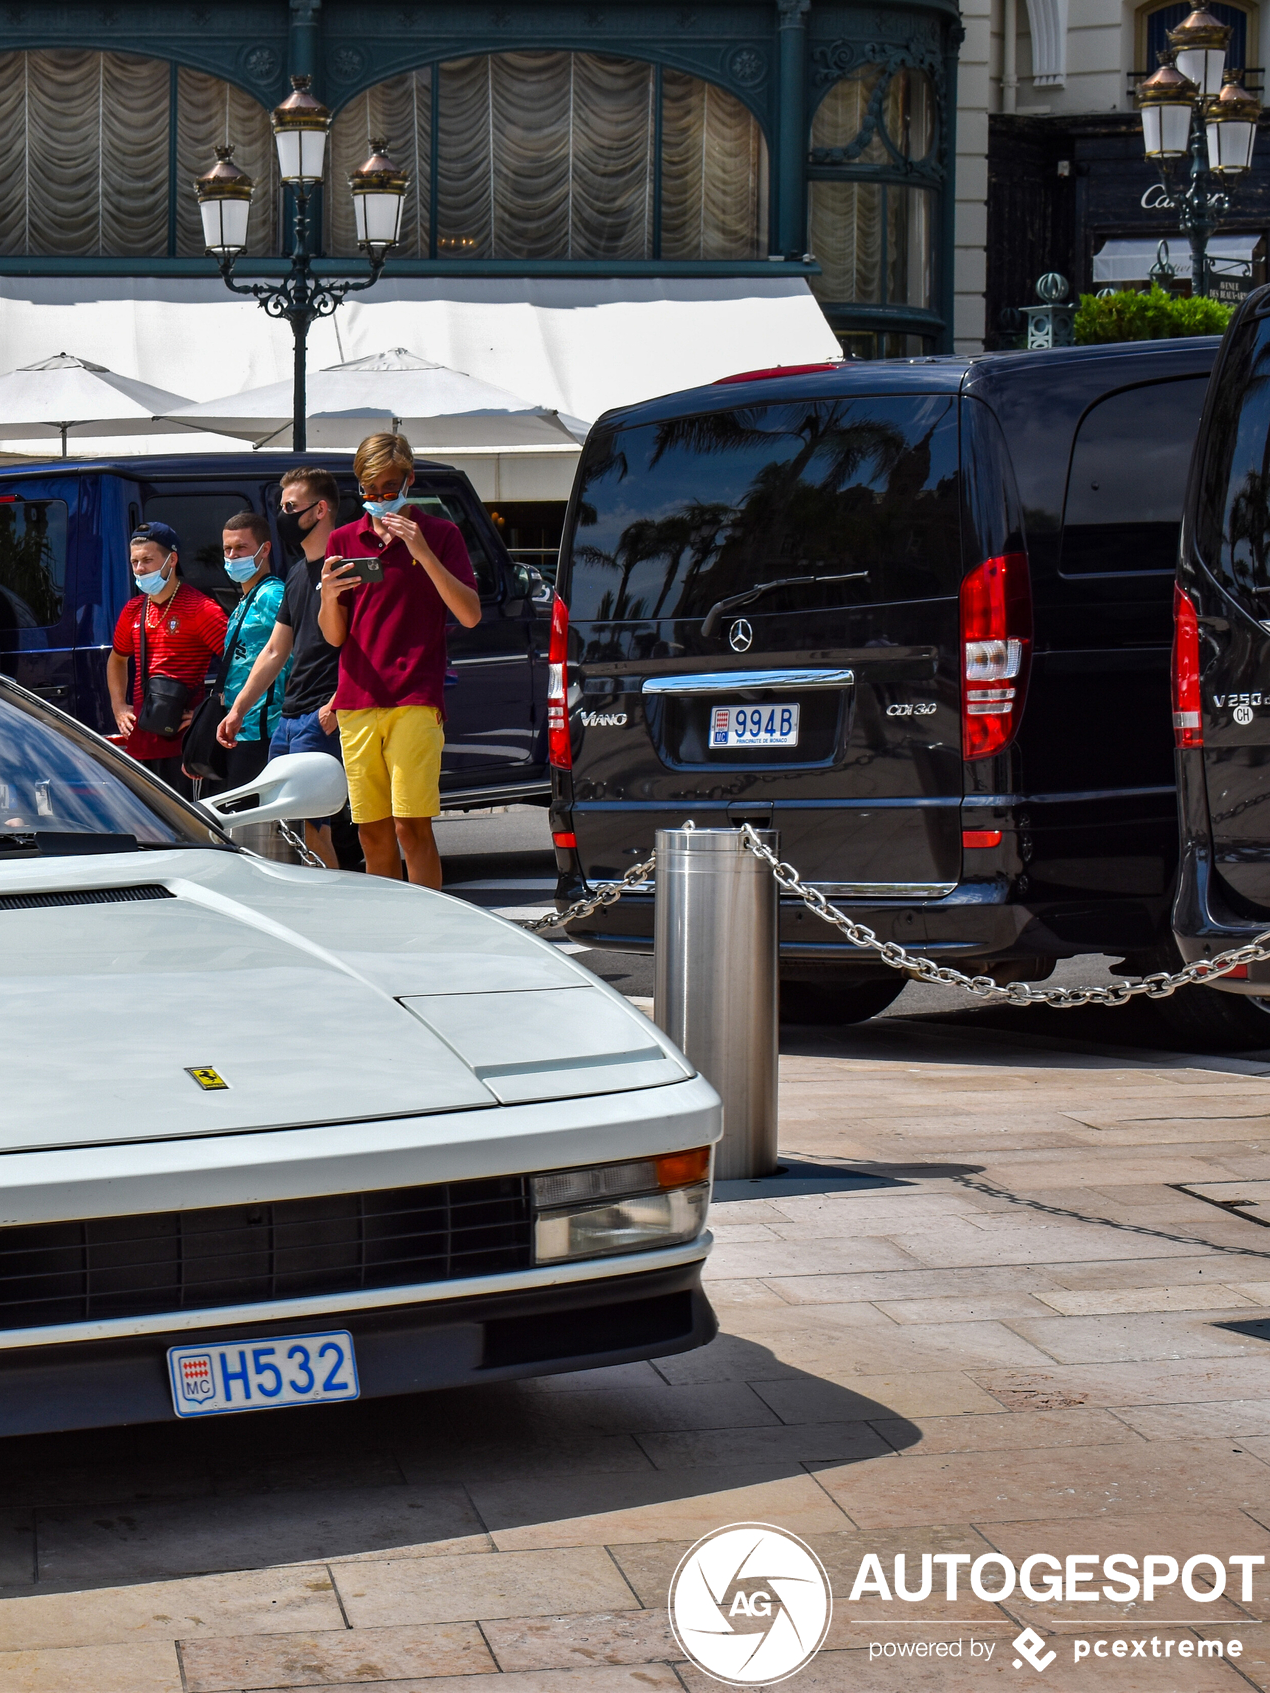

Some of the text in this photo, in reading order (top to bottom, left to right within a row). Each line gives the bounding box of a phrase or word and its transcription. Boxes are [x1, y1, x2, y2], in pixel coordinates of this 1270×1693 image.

[1213, 694, 1226, 708] V
[1228, 692, 1261, 707] 250
[580, 711, 628, 727] VIANO
[735, 708, 792, 738] 994B
[1236, 708, 1250, 722] CH
[716, 732, 726, 742] MC
[219, 1342, 349, 1402] H532
[186, 1379, 211, 1396] MC
